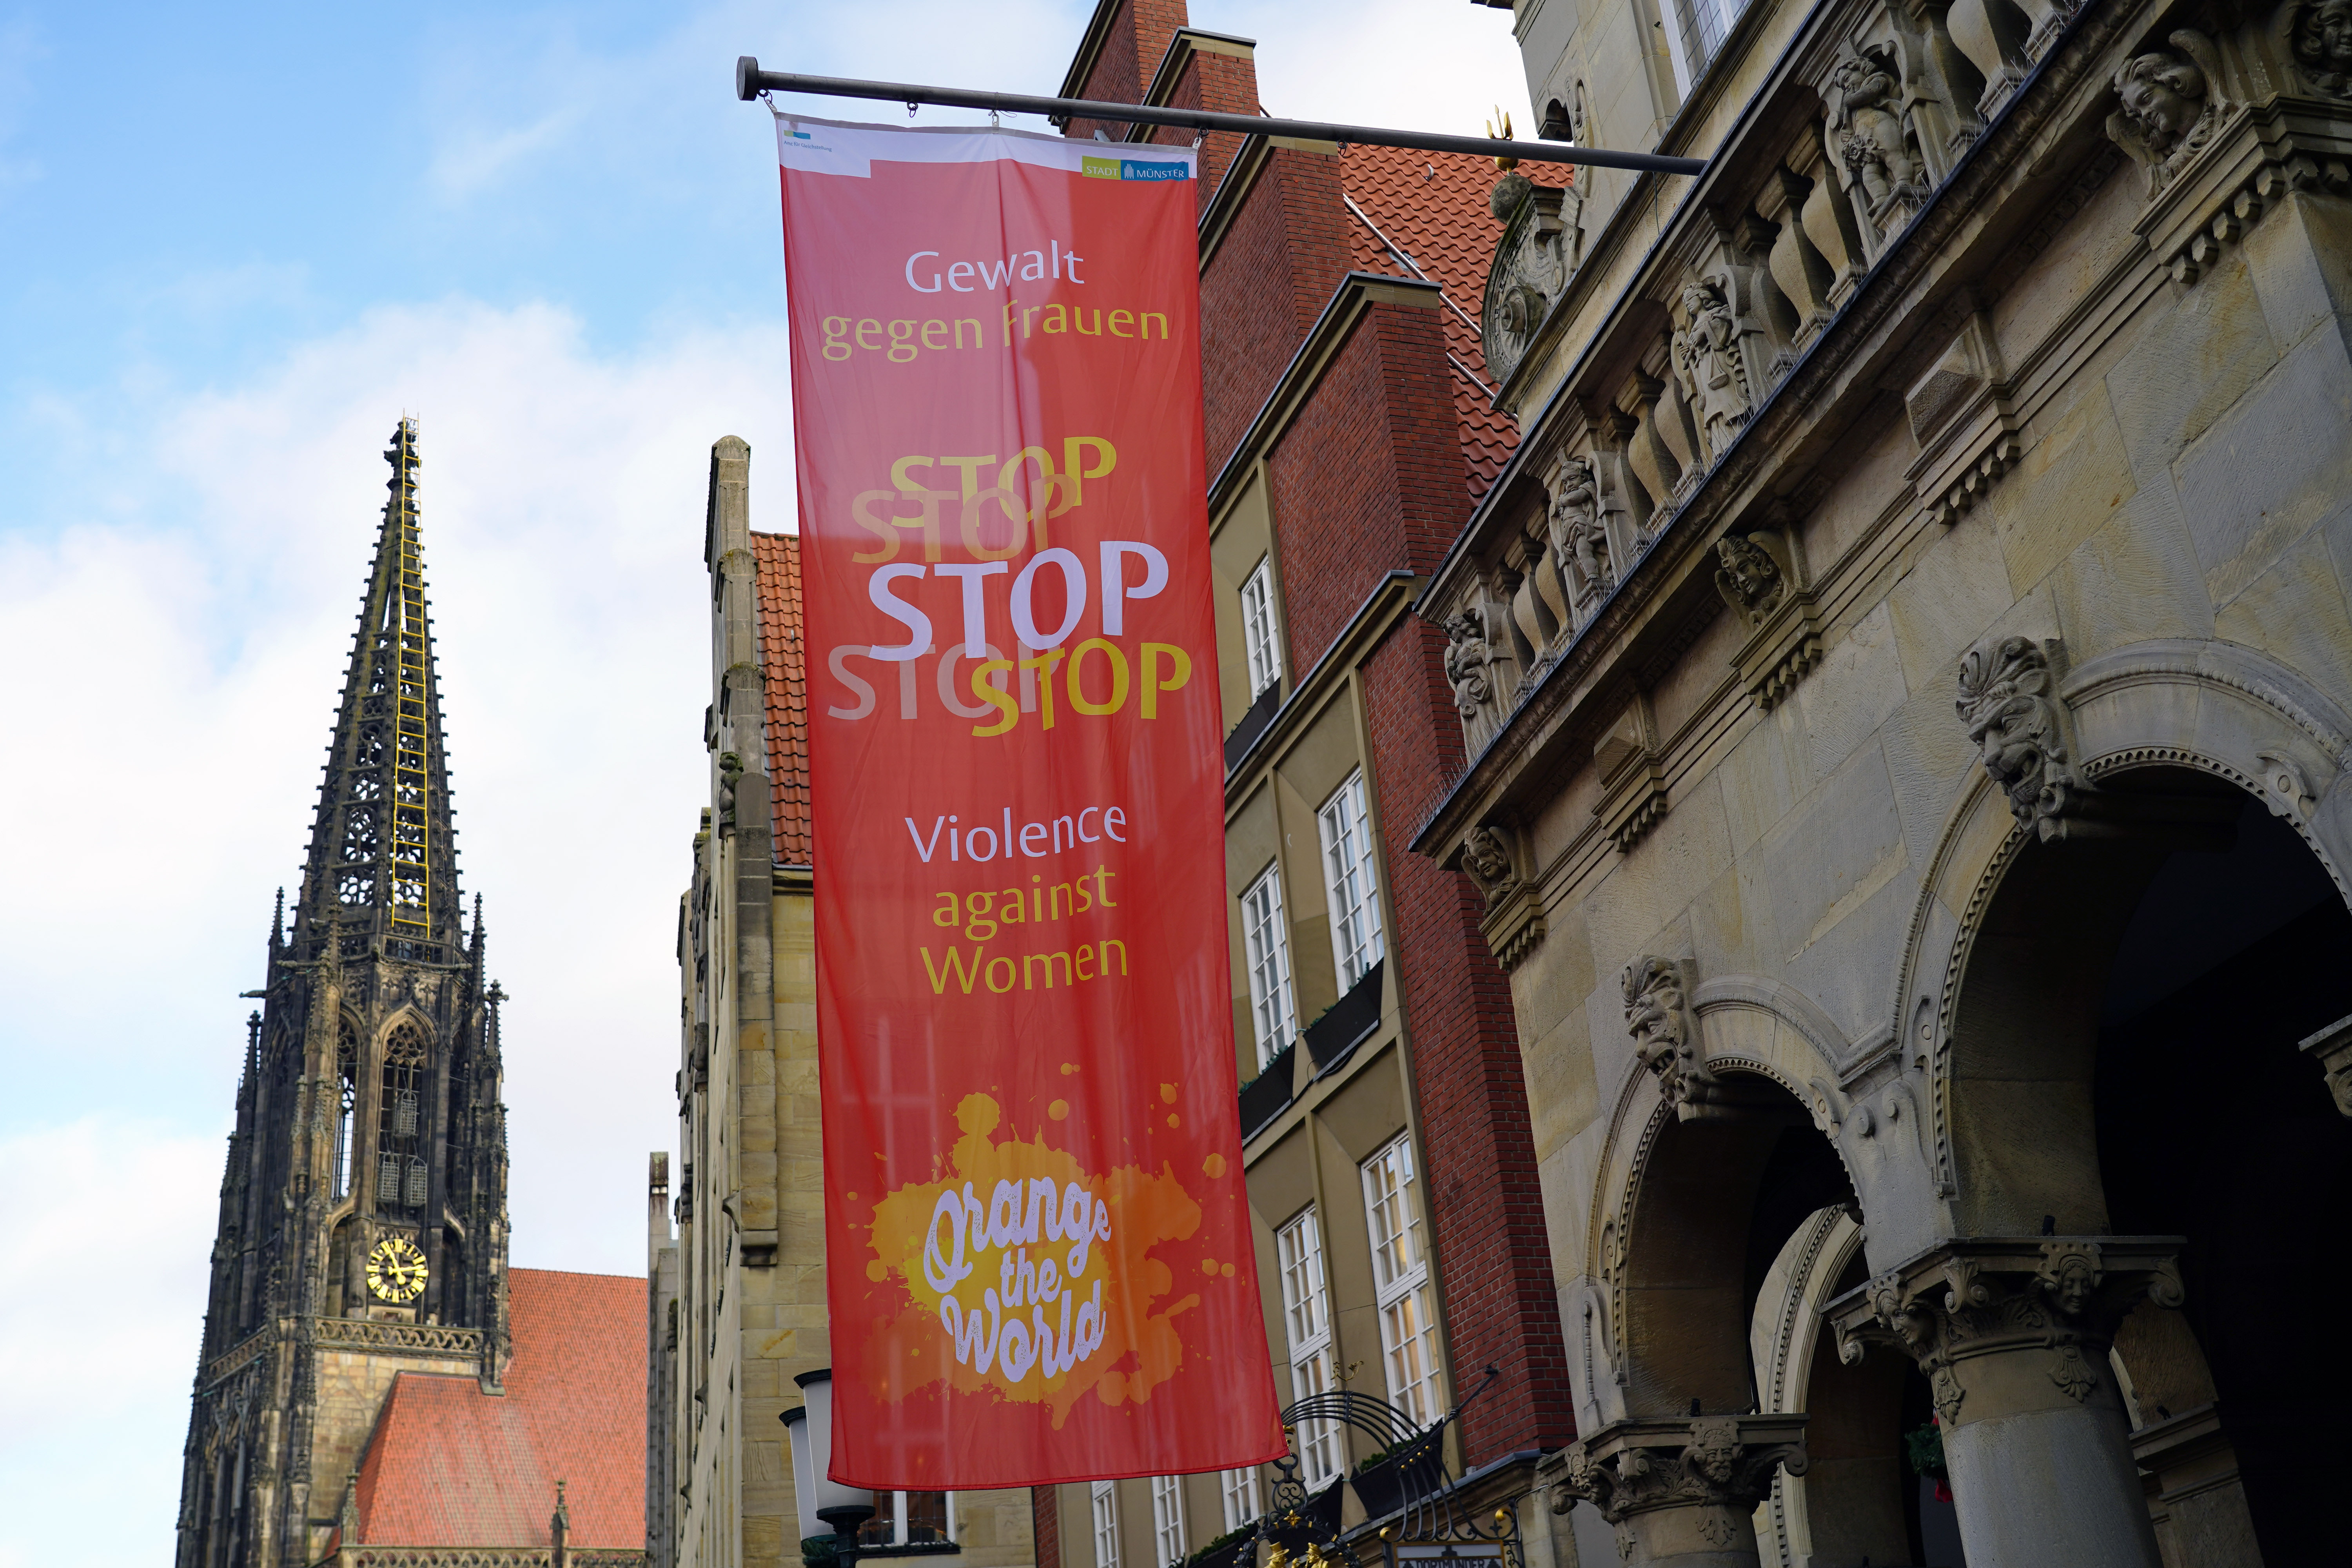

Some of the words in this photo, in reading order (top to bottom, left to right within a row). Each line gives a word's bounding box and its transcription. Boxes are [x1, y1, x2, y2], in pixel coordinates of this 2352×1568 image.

[801, 143, 832, 152] Gleichstellung
[1086, 166, 1118, 176] STADT
[1137, 168, 1184, 178] MÜNSTER
[905, 240, 1085, 293] Gewalt
[822, 315, 983, 363] gegen
[1002, 299, 1169, 348] Frauen
[890, 436, 1118, 528] STOP
[851, 473, 1078, 564] STOP
[867, 540, 1169, 662] STOP
[970, 637, 1192, 737] STOP
[904, 806, 1127, 863] Violence
[932, 864, 1118, 942] against
[919, 938, 1128, 995] Women
[923, 1176, 1112, 1294] Orange
[1000, 1247, 1062, 1308] the
[940, 1279, 1107, 1383] World
